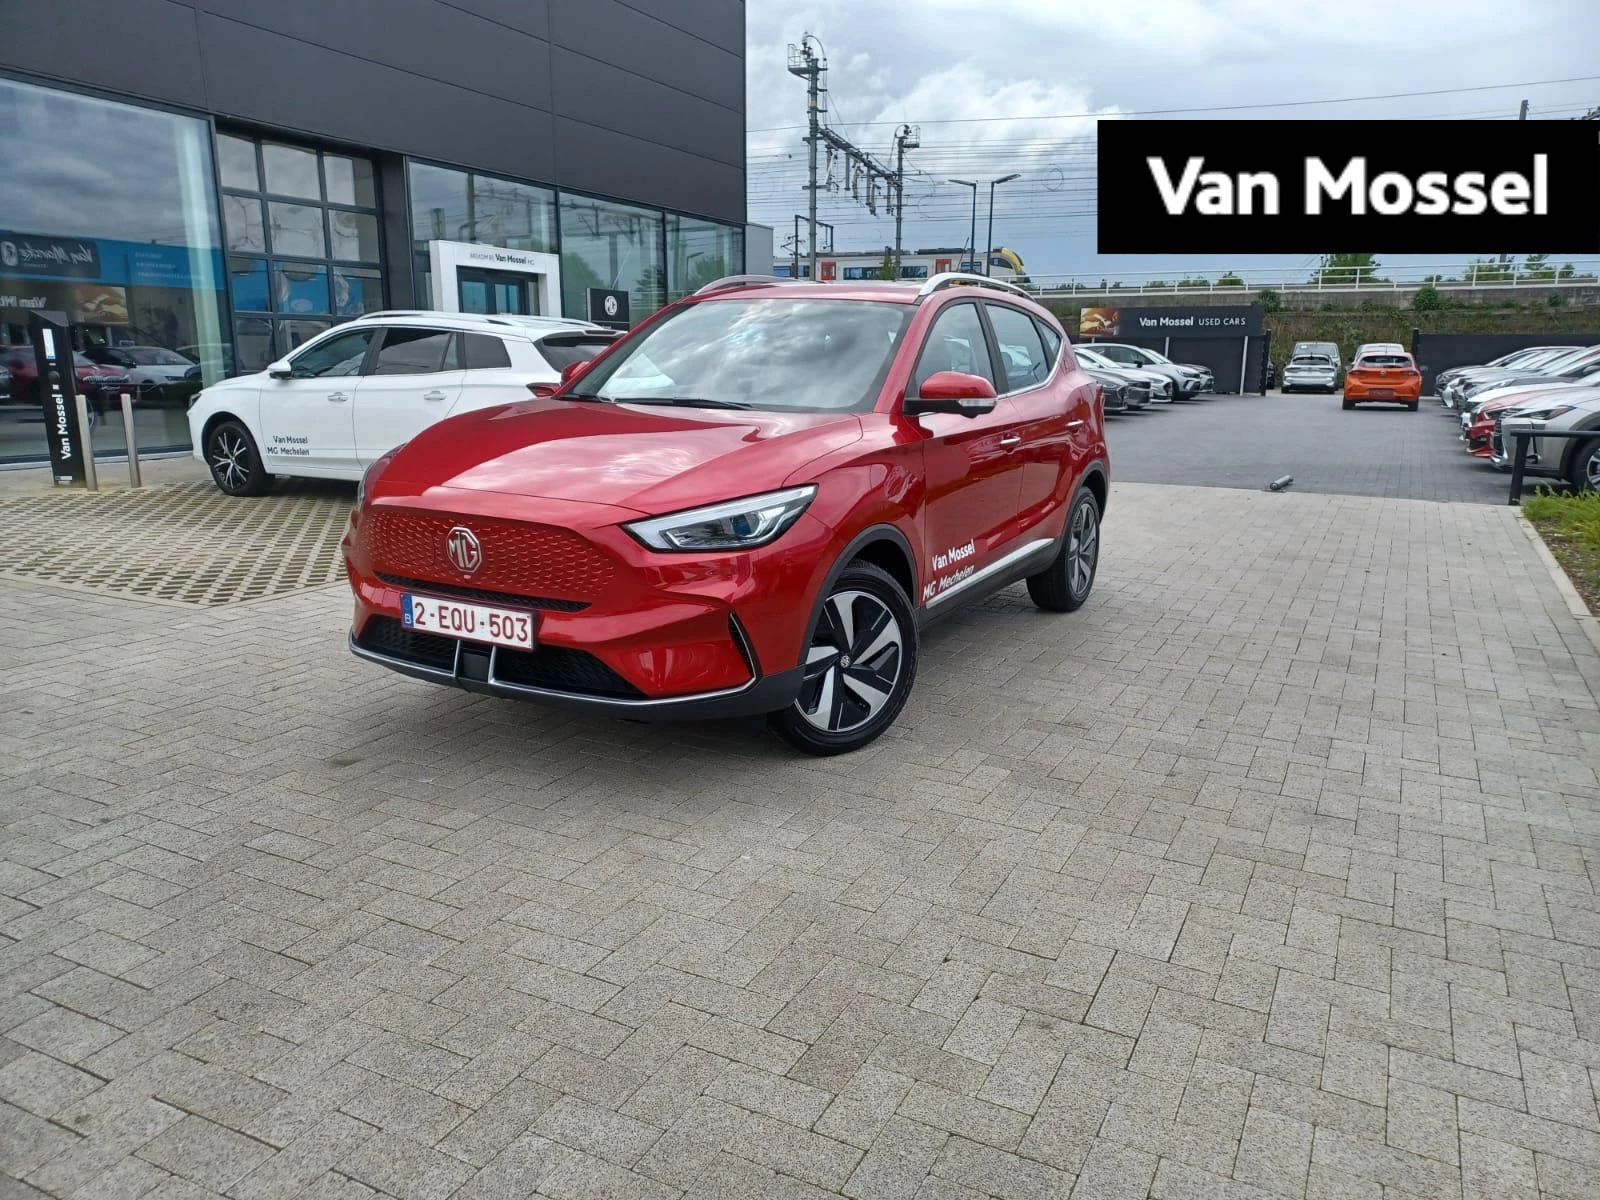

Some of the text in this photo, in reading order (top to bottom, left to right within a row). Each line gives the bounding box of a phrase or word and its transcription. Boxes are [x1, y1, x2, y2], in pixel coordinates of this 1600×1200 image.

[1139, 316, 1246, 327] Van Mossel USED CARS
[52, 393, 72, 460] Van Mossel
[272, 435, 308, 444] Van Mossel
[267, 446, 310, 456] MG Mechelen
[447, 528, 481, 570] MG
[931, 538, 976, 572] Van Mossel
[922, 564, 975, 602] MG Mechelen
[404, 601, 529, 642] B 2-EQU-503
